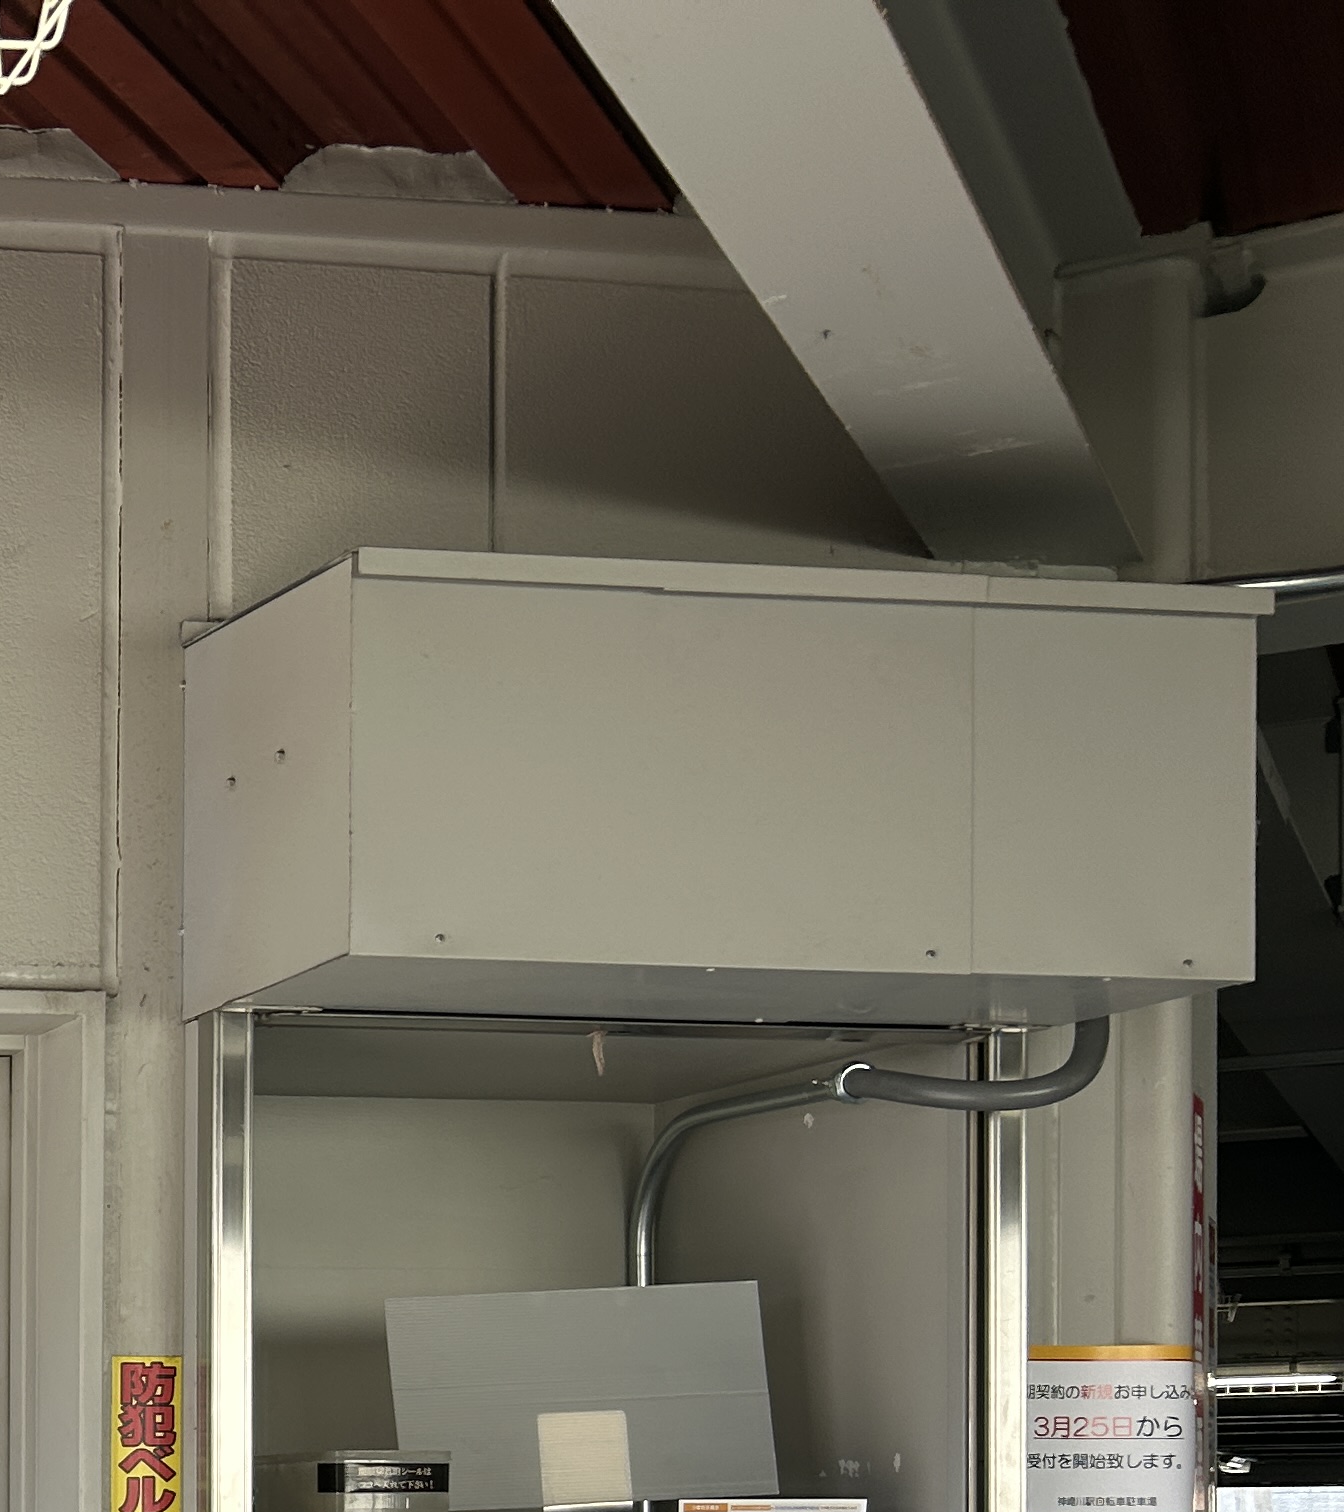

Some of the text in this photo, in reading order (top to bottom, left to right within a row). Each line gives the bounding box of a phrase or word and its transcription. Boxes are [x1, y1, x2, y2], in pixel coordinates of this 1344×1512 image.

[1033, 1415, 1184, 1438] 3月25日から
[1026, 1453, 1183, 1470] 受付を開始致します。
